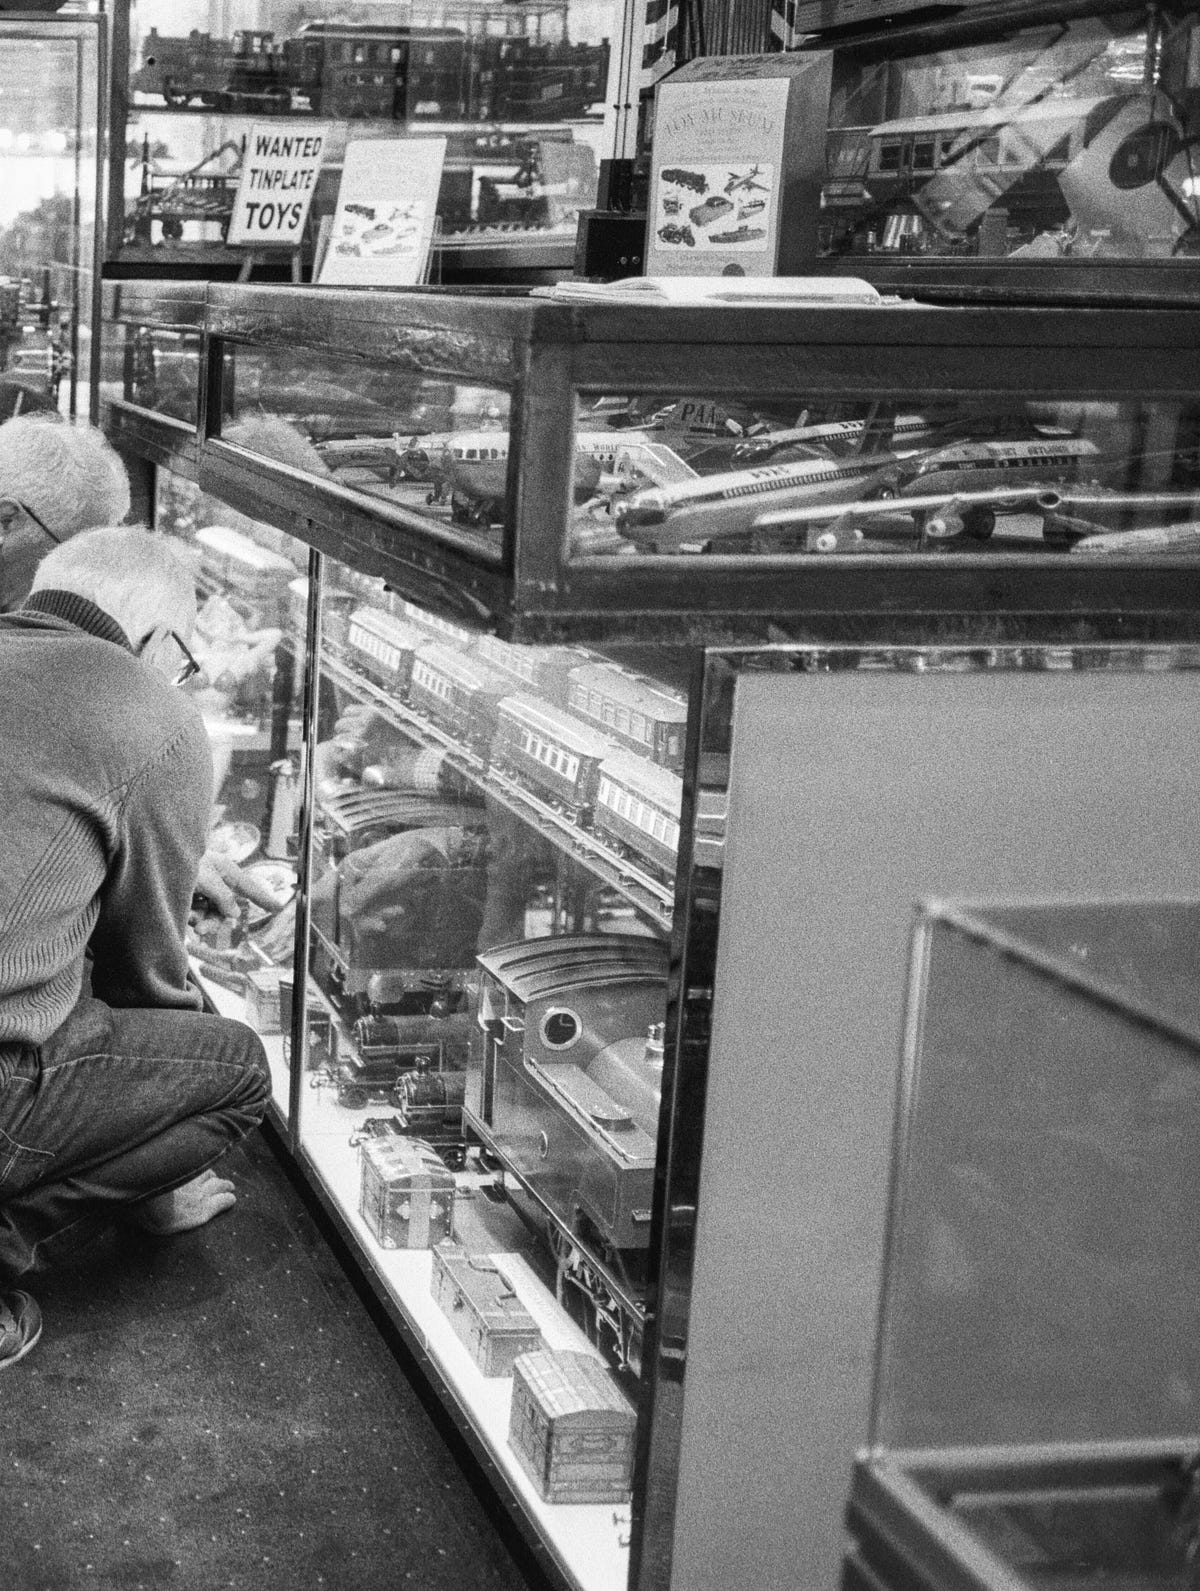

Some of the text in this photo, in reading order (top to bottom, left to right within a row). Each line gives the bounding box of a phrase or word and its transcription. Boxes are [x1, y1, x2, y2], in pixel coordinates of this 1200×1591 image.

[256, 136, 322, 157] WANTED
[250, 168, 315, 190] TINPLATE
[246, 202, 303, 230] TOYS
